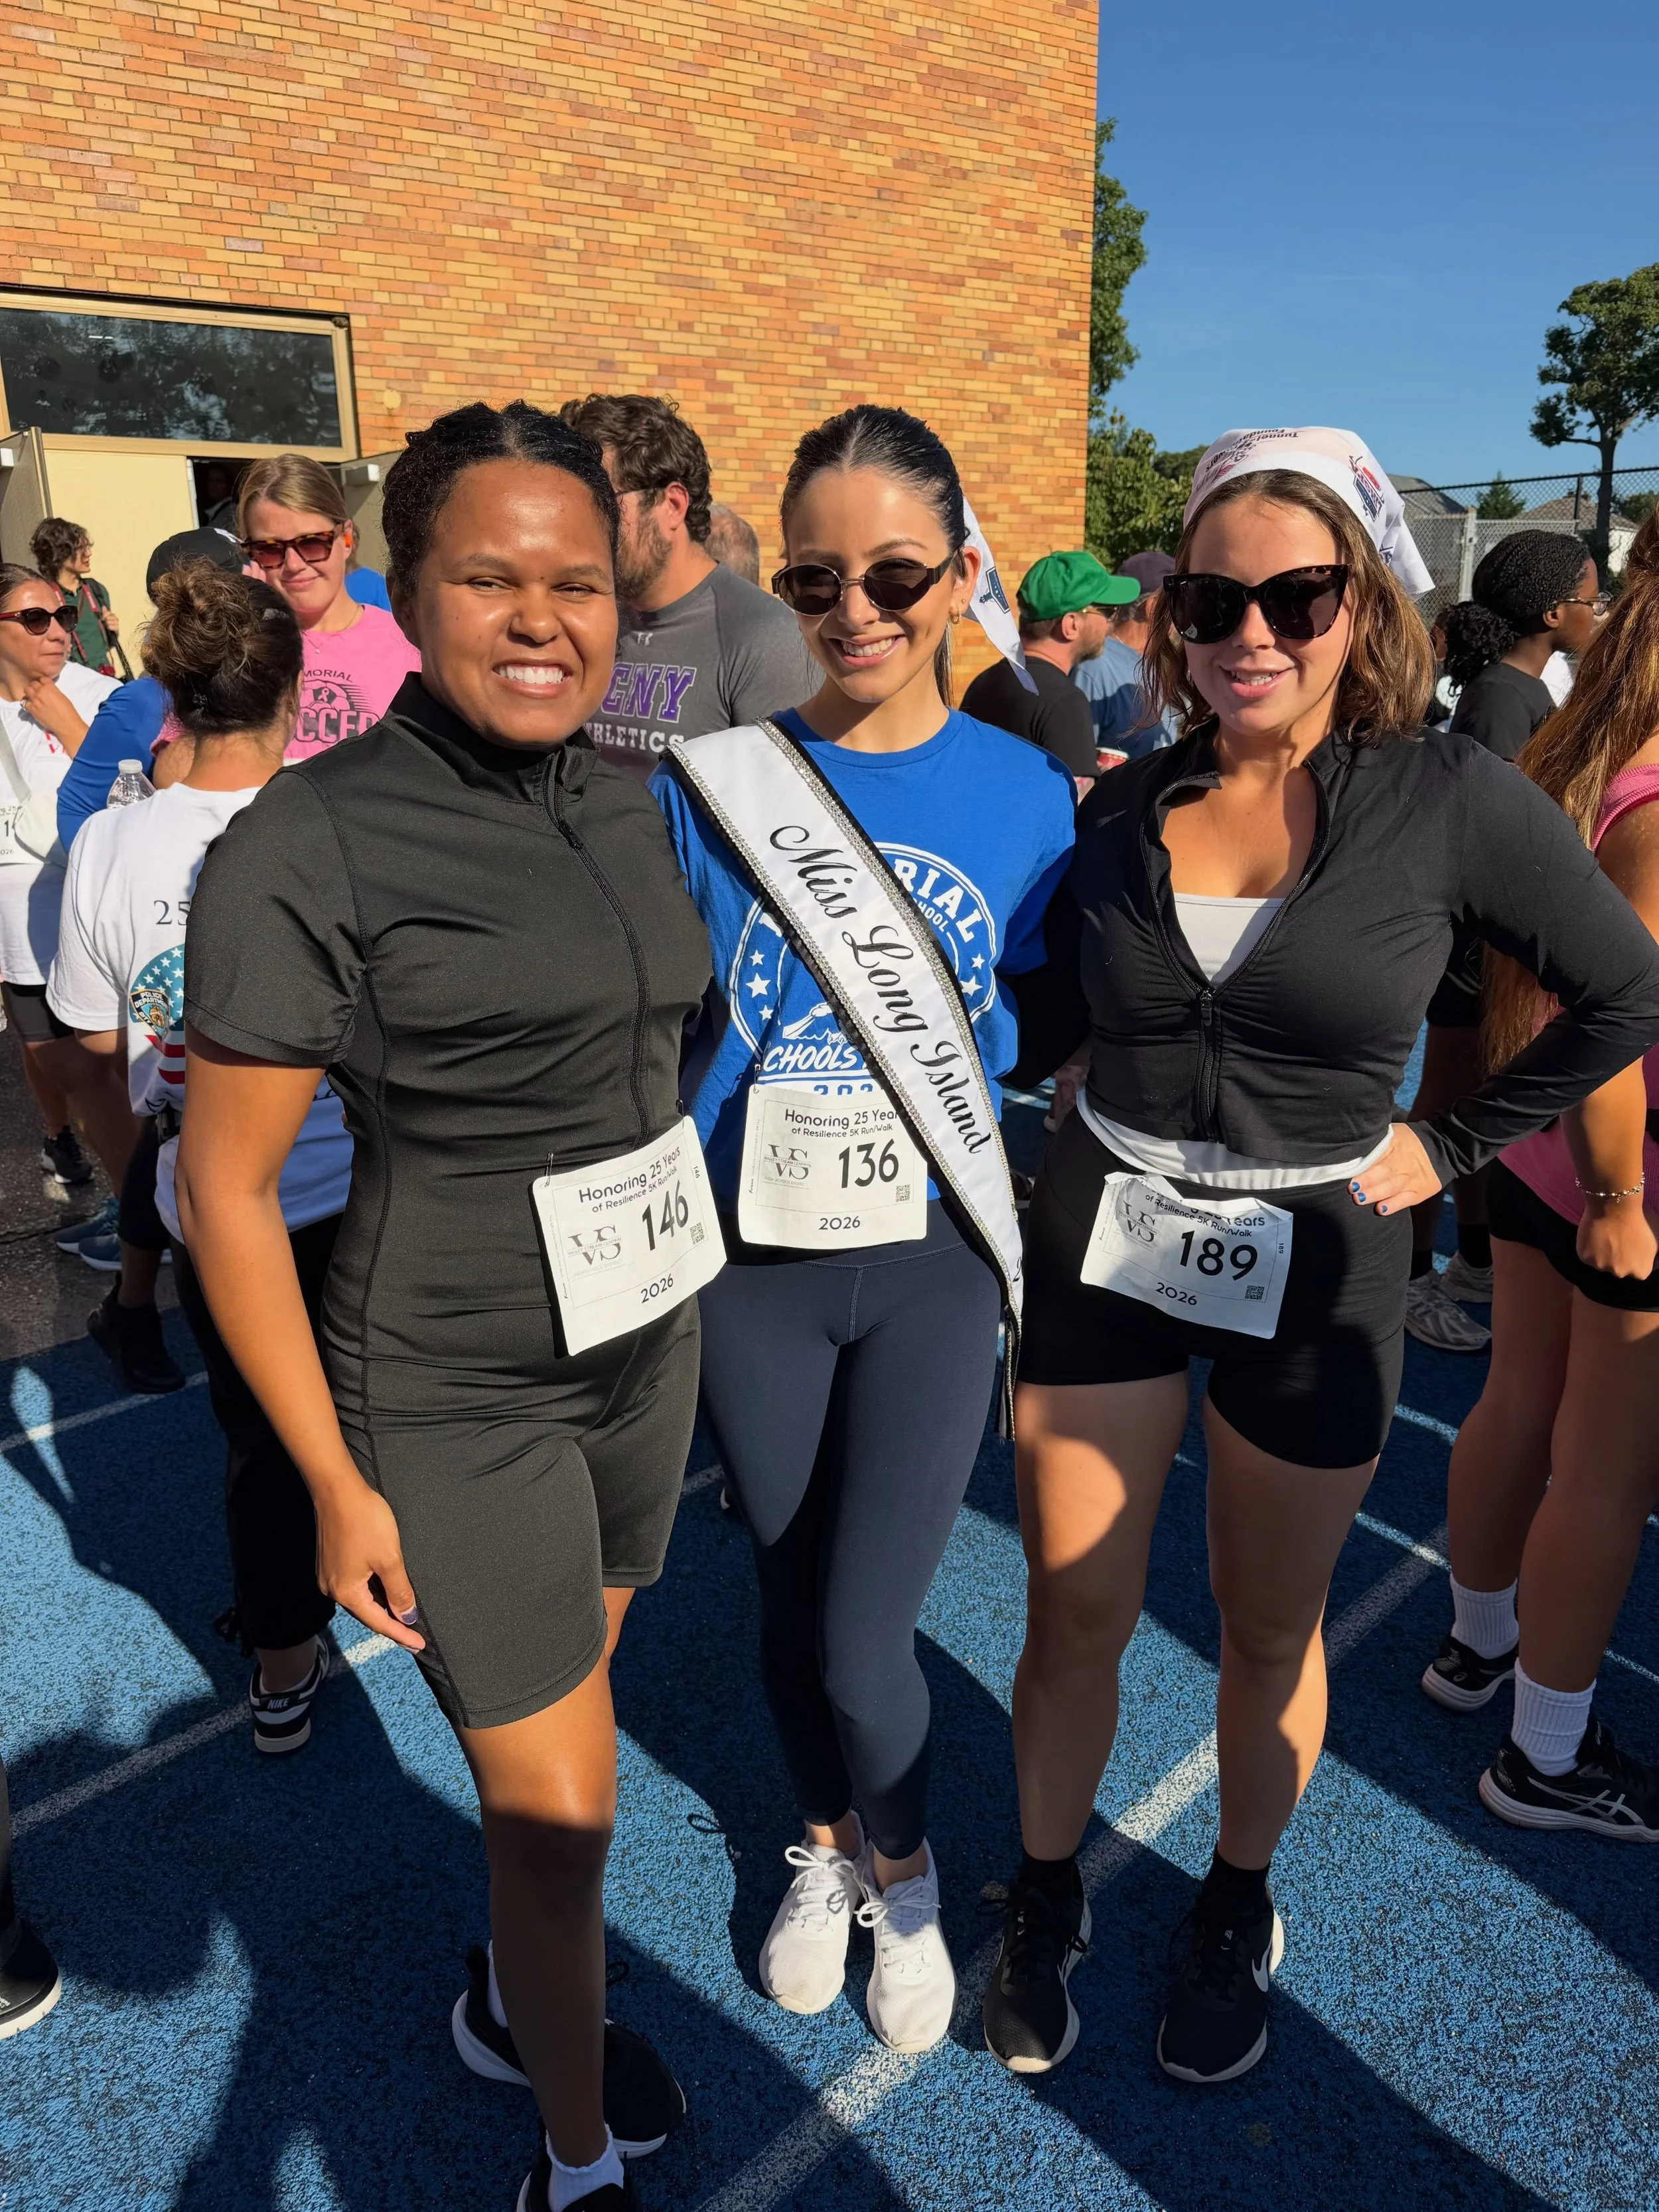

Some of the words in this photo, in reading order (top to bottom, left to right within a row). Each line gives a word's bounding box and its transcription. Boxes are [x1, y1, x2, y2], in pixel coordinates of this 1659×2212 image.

[140, 992, 164, 1000] POLICE
[770, 826, 858, 919] Miss
[841, 925, 929, 1032] Long
[910, 1041, 991, 1154] Island
[139, 1011, 152, 1024] CITY
[784, 1109, 849, 1130] Honoring
[853, 1111, 869, 1125] 25
[804, 1128, 847, 1138] Resilience
[861, 1123, 893, 1134] Run/Walk
[579, 1173, 646, 1203] Honoring
[650, 1160, 662, 1179] 25
[662, 1147, 680, 1169] Years
[767, 1143, 809, 1180] VS
[839, 1138, 899, 1189] 136
[592, 1203, 603, 1213] of
[606, 1189, 646, 1209] Resilience
[648, 1181, 657, 1193] 5K
[642, 1179, 688, 1251] 146
[819, 1216, 861, 1230] 2026
[1155, 1199, 1195, 1220] Resilience
[1197, 1216, 1209, 1226] 5K
[1211, 1221, 1252, 1237] Run/Walk
[568, 1224, 621, 1265] VS
[1180, 1230, 1258, 1281] 189
[640, 1273, 674, 1304] 2026
[1155, 1282, 1197, 1305] 2026
[267, 1698, 289, 1710] NIKE
